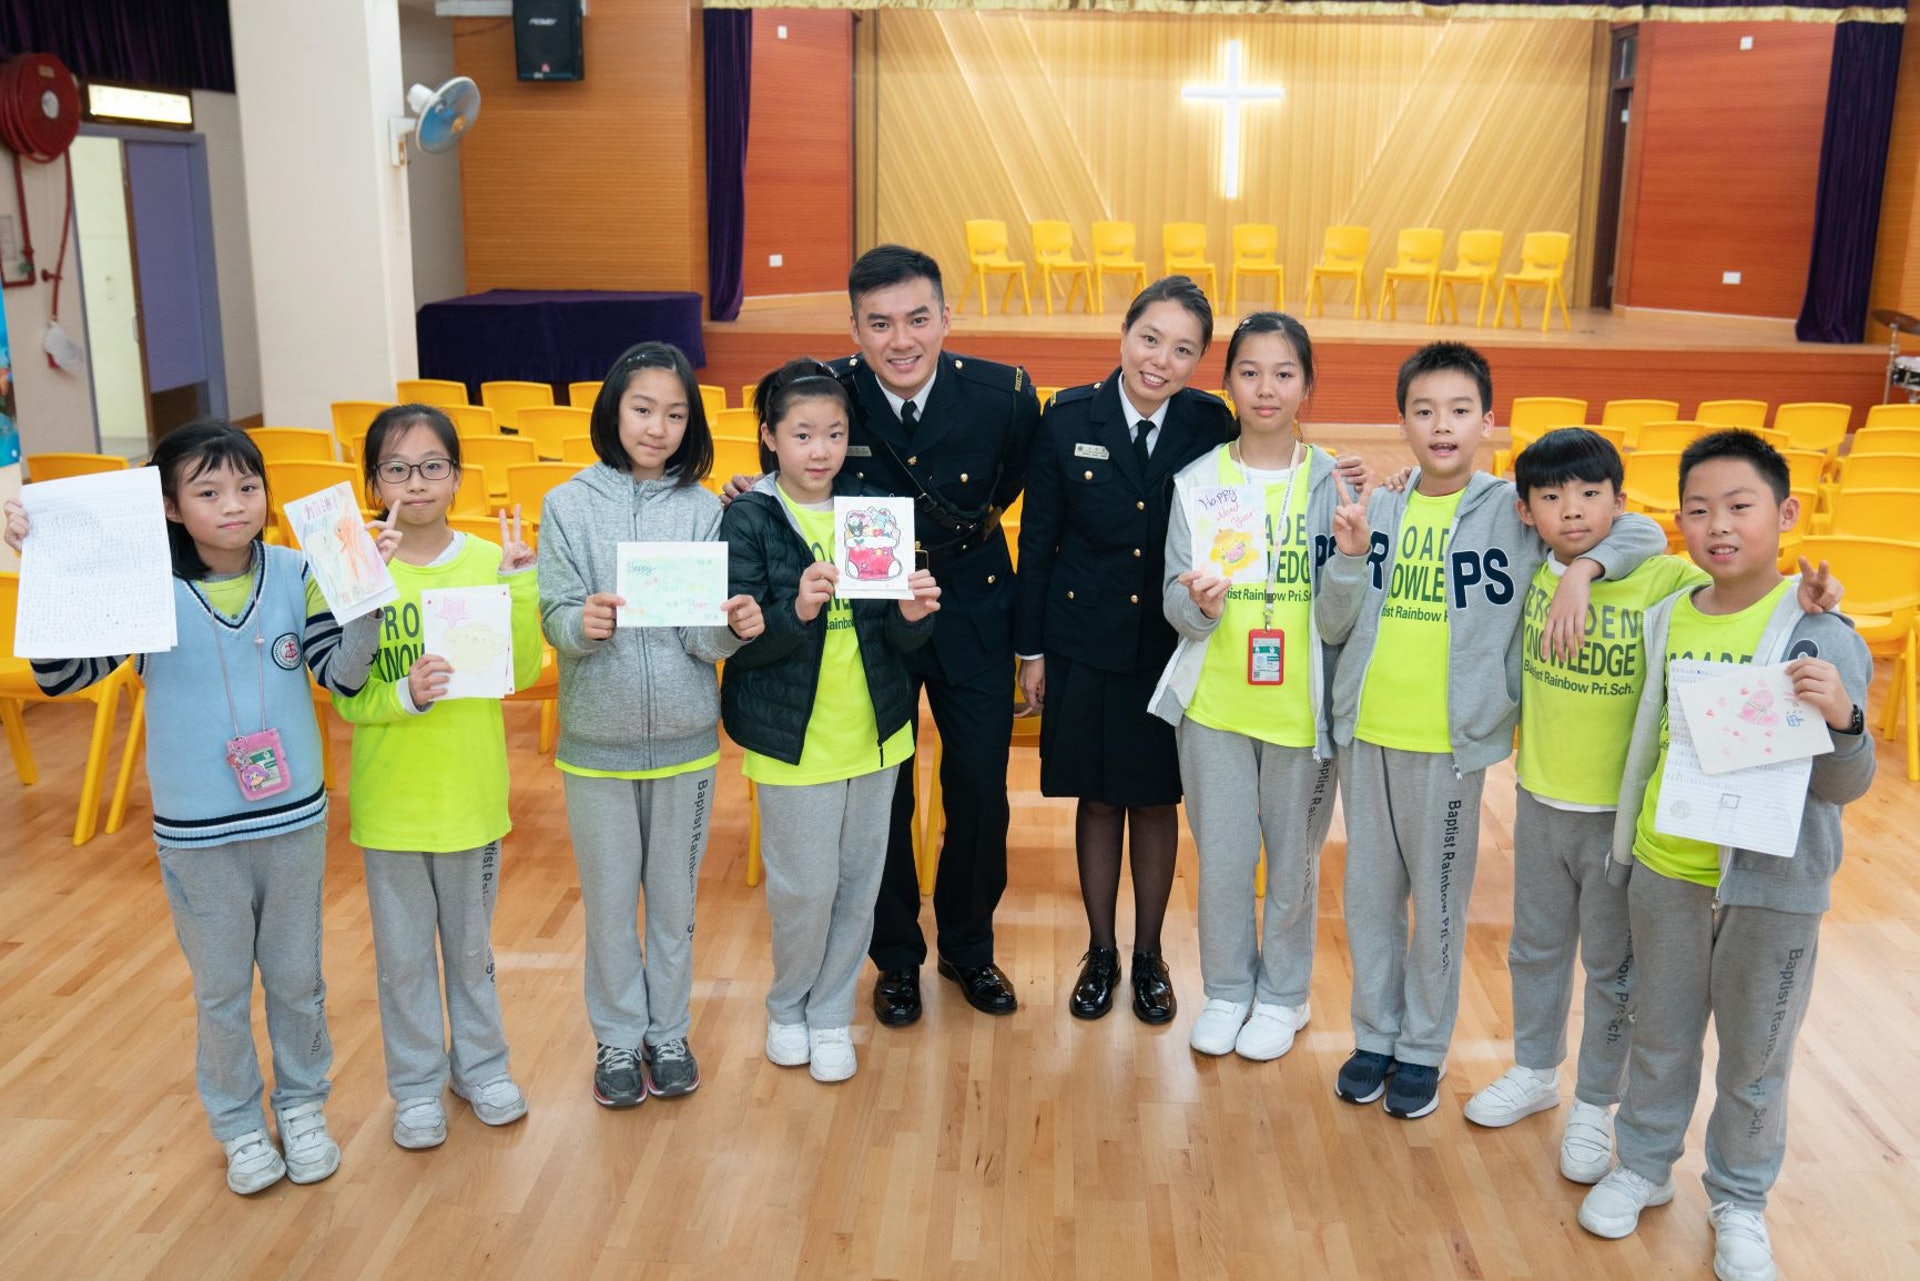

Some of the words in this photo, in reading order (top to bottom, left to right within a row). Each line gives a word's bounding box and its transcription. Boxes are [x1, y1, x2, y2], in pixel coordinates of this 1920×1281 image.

[1198, 486, 1238, 511] Happy
[1242, 588, 1287, 601] Rainow
[1451, 548, 1515, 609] PS
[1396, 605, 1442, 623] Rainbow
[1544, 670, 1589, 694] Rainbow
[692, 779, 709, 831] Baptist
[1444, 800, 1462, 849] Baptist
[1441, 851, 1456, 914] Rainbow
[1776, 949, 1804, 1007] Baptist
